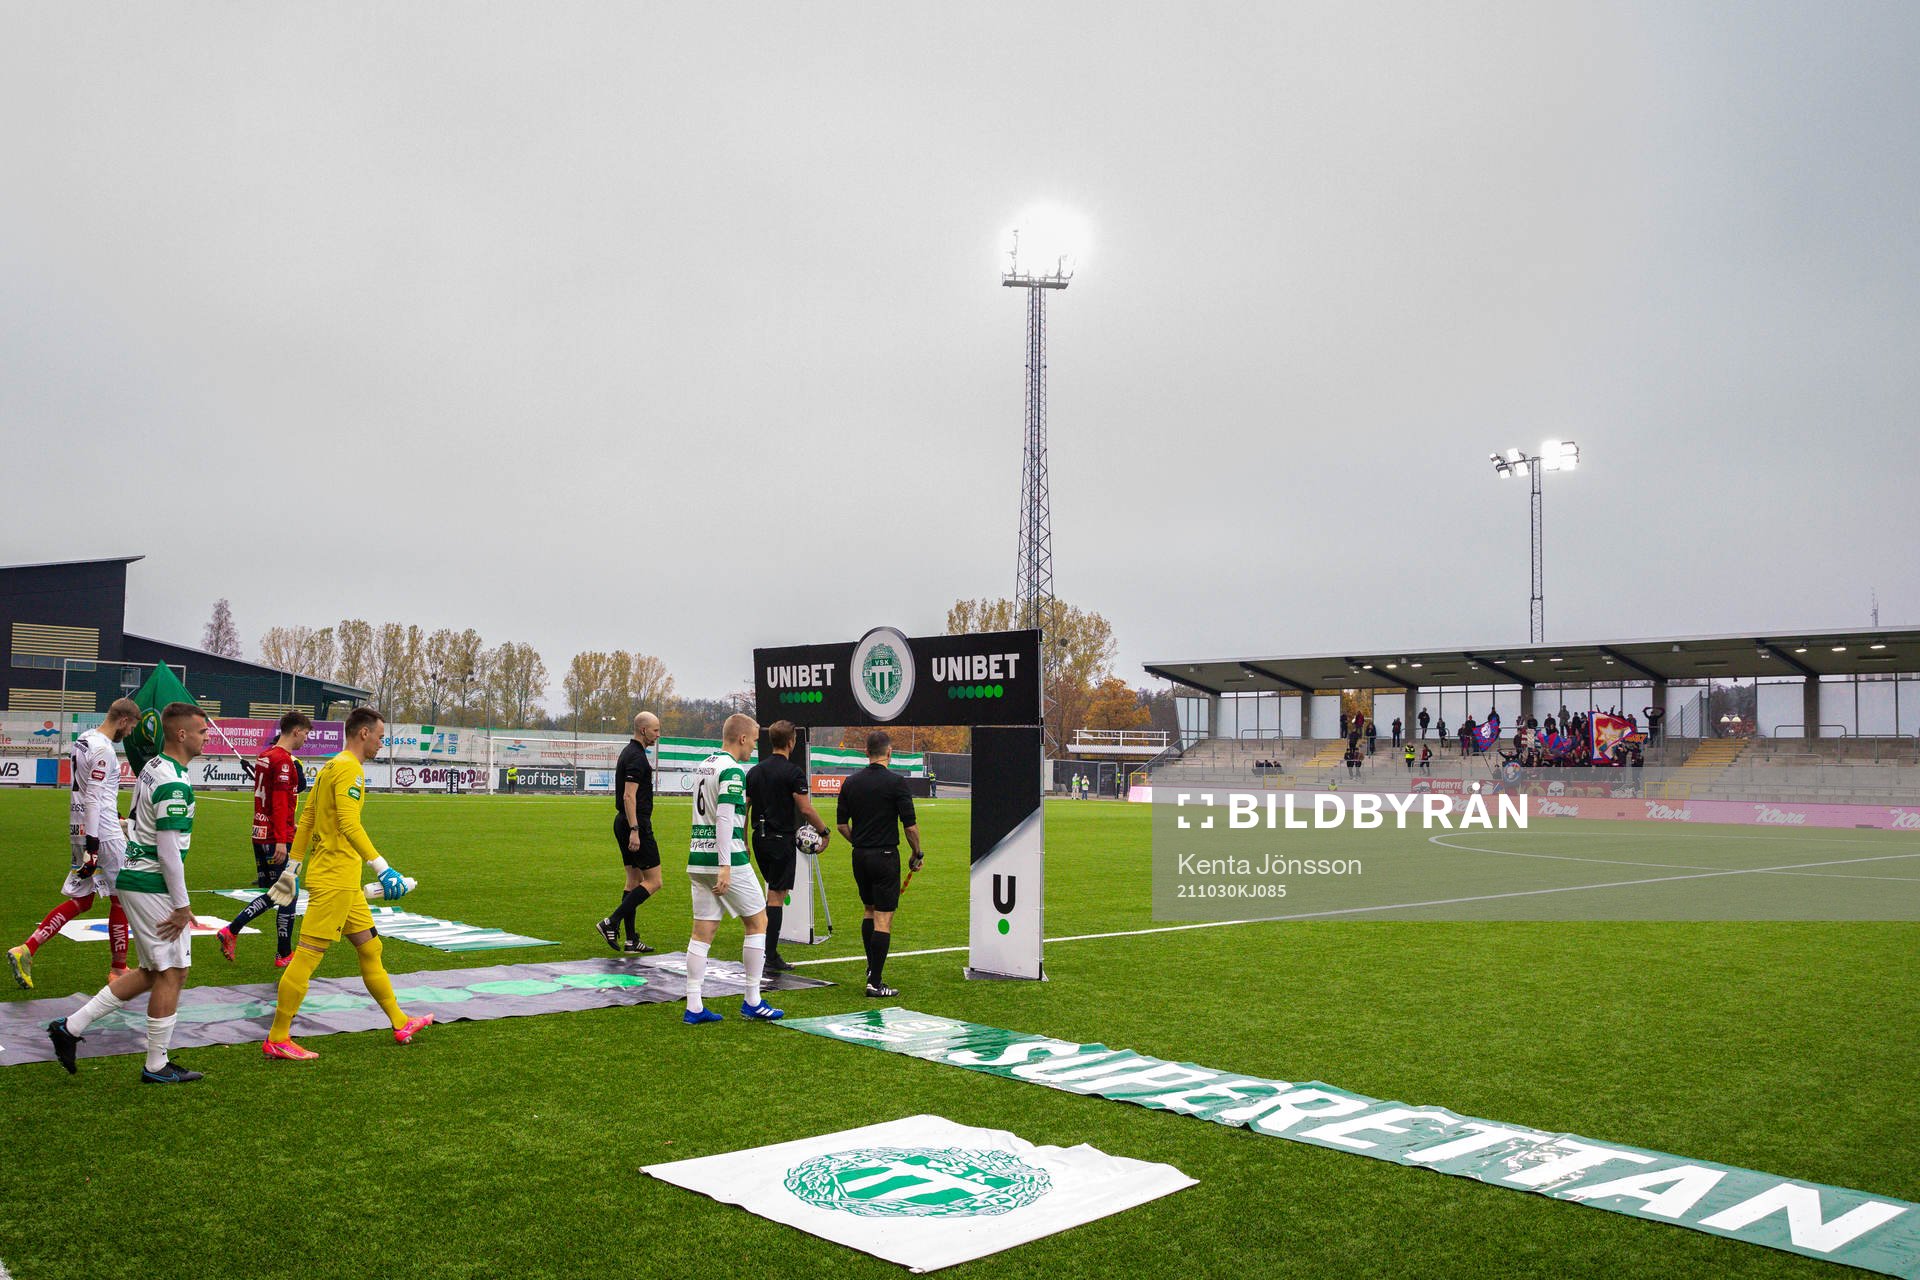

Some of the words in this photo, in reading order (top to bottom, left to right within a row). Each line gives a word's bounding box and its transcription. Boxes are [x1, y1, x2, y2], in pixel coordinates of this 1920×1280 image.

[767, 663, 835, 688] UNIBET
[932, 653, 1020, 683] UNIBET
[527, 772, 540, 785] of
[541, 772, 559, 785] the
[818, 778, 841, 787] renta
[697, 778, 706, 816] 6
[992, 873, 1016, 914] U
[244, 897, 268, 918] MIKE
[39, 912, 66, 939] MIKE
[112, 924, 126, 952] MIKE
[278, 913, 289, 938] MIKE
[947, 1041, 1908, 1253] SUPERETTAN
